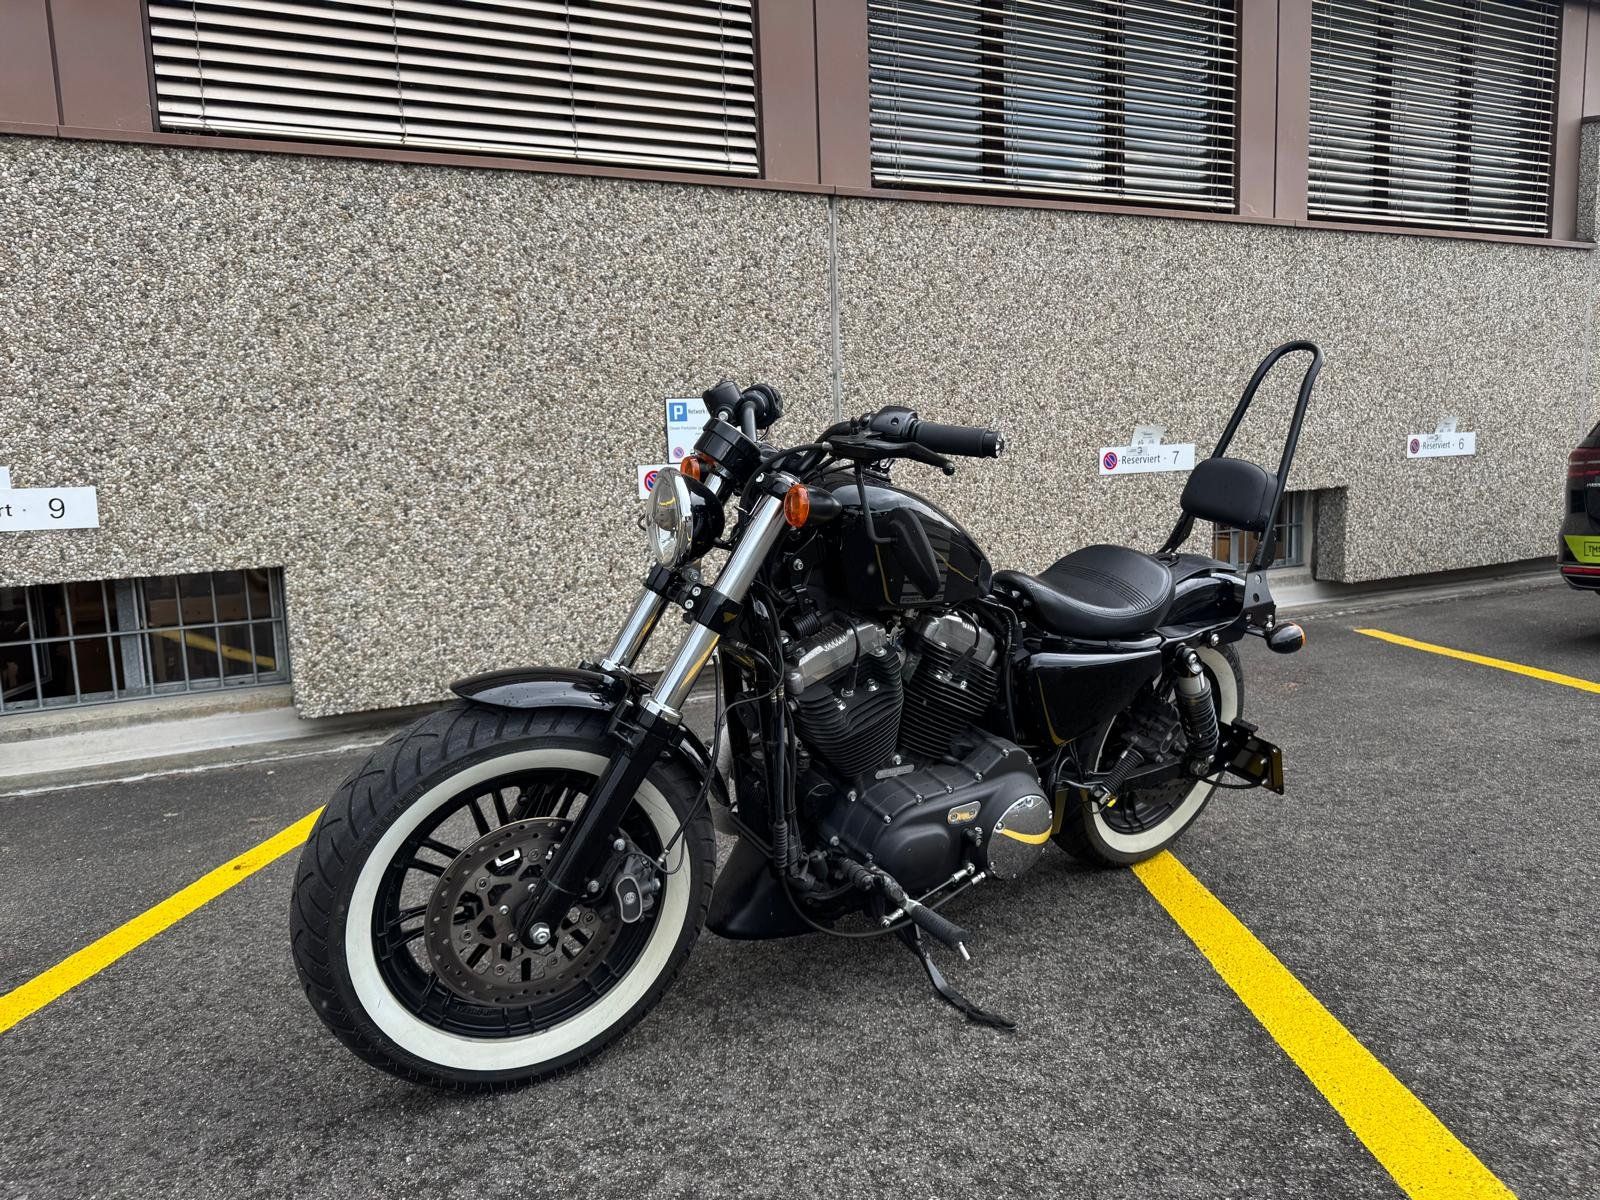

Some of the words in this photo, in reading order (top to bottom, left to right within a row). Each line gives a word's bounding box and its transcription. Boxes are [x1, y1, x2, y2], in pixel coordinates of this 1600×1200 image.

[673, 405, 684, 420] P
[1422, 441, 1451, 449] Reserviert
[1459, 438, 1464, 449] 6
[1122, 452, 1160, 464] Reserviert
[1172, 451, 1180, 464] 7
[48, 498, 65, 519] 9
